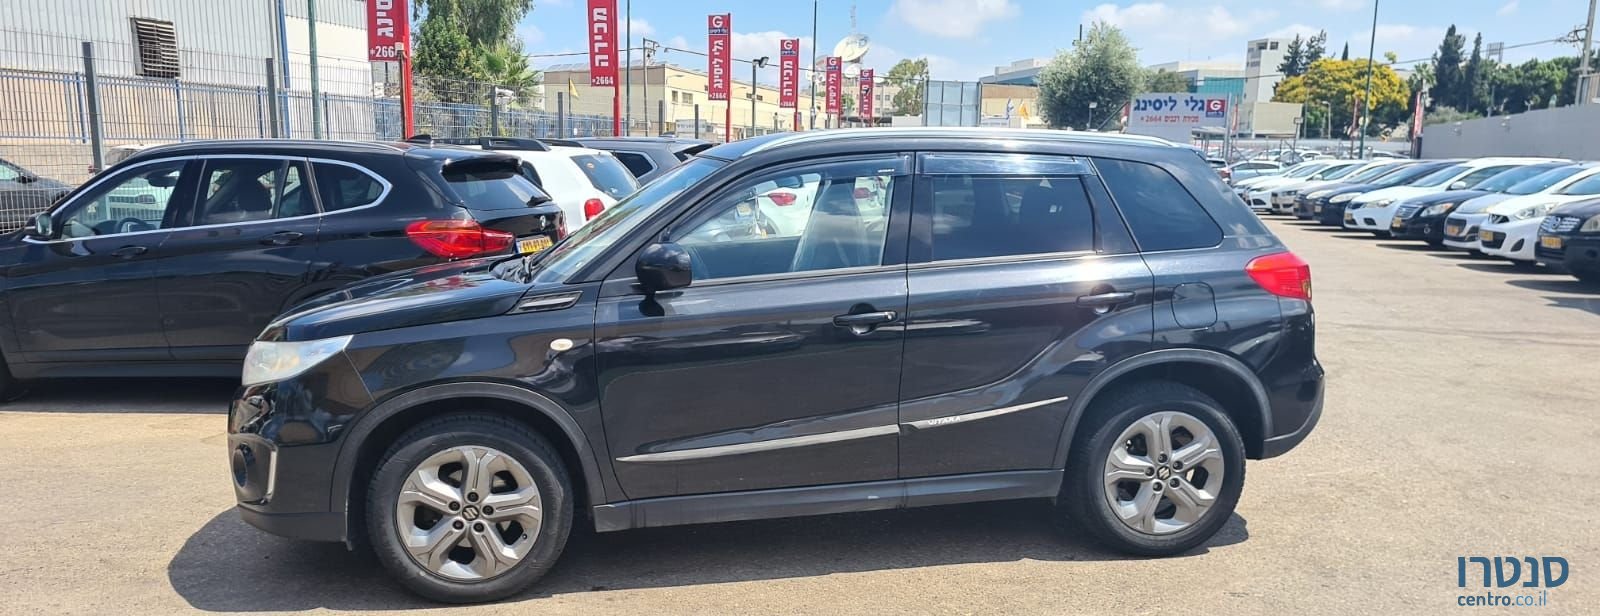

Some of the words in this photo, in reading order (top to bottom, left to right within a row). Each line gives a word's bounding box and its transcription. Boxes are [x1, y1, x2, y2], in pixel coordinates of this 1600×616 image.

[712, 15, 723, 28] G
[593, 7, 609, 67] מכירה
[783, 40, 793, 50] G
[370, 45, 398, 58] 266
[712, 39, 724, 55] גלי
[829, 58, 837, 66] G
[712, 58, 724, 89] ליסינג
[783, 60, 793, 97] מכירה
[1133, 95, 1178, 112] ליסינג
[1185, 95, 1205, 112] גלי
[1209, 100, 1222, 111] G
